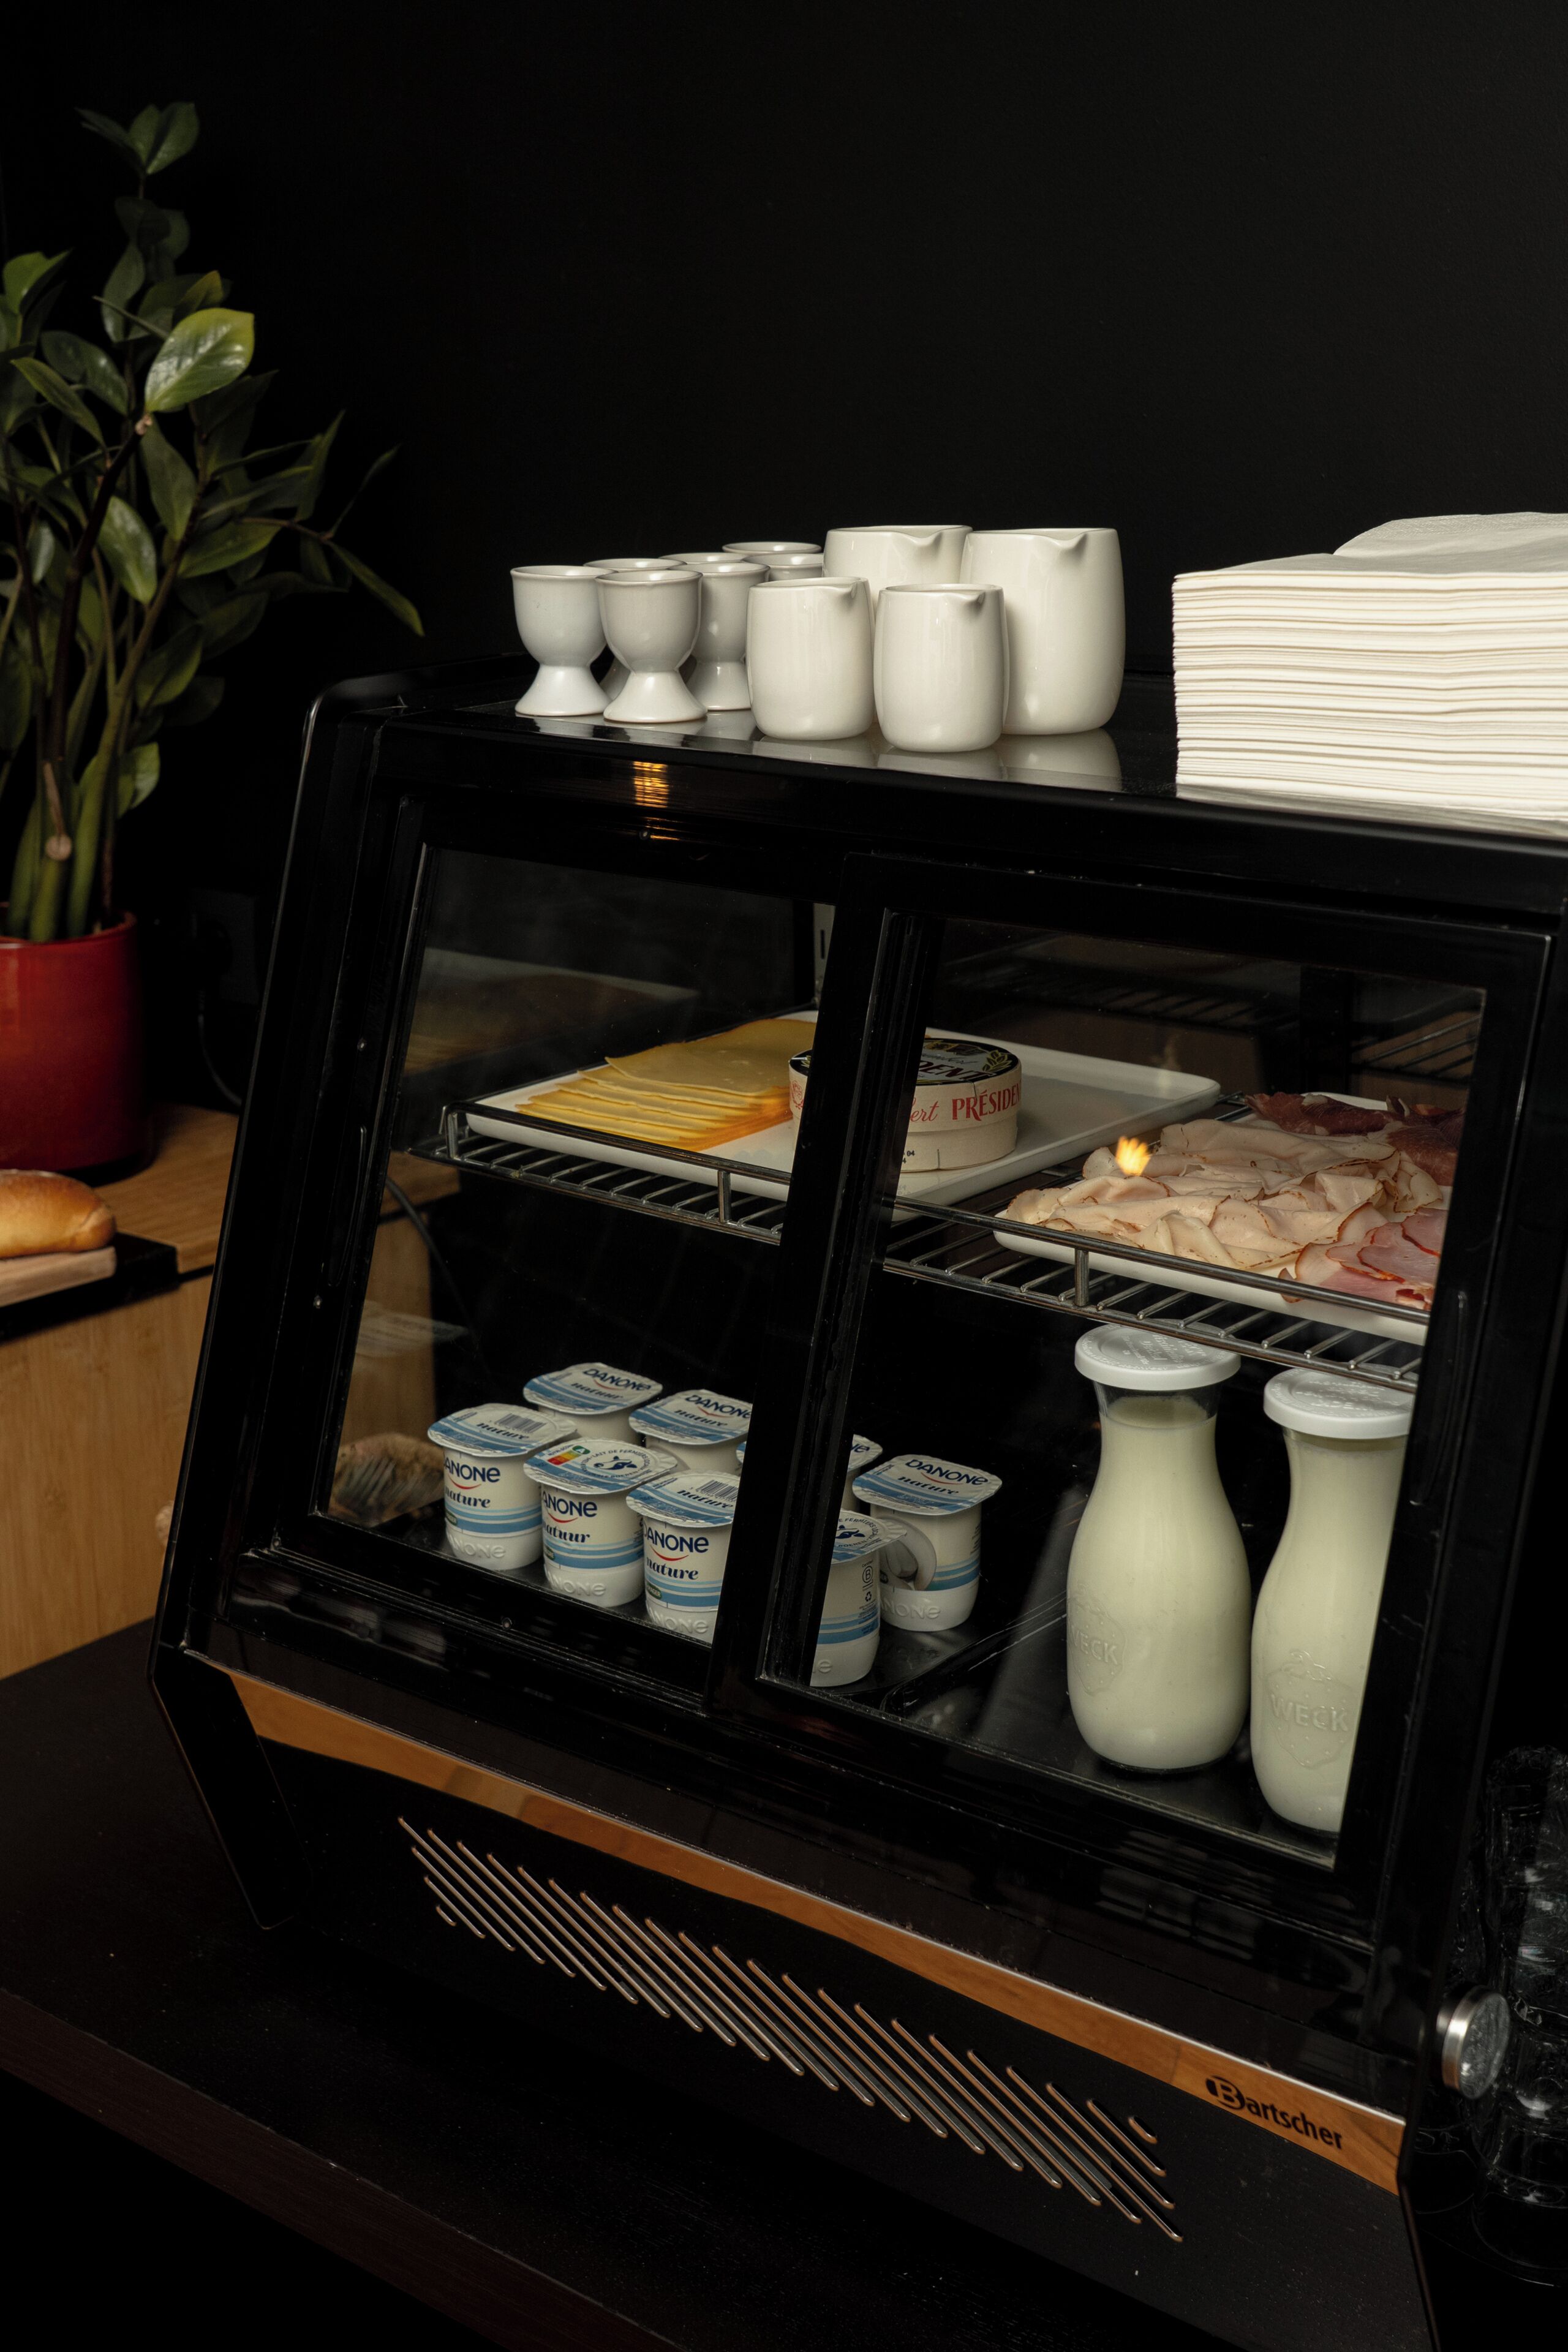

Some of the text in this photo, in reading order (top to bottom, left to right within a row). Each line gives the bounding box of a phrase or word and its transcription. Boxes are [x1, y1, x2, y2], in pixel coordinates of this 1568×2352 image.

[444, 1457, 500, 1483] ANONE
[542, 1490, 598, 1518] ANONE
[1205, 2075, 1342, 2150] Bartscher
